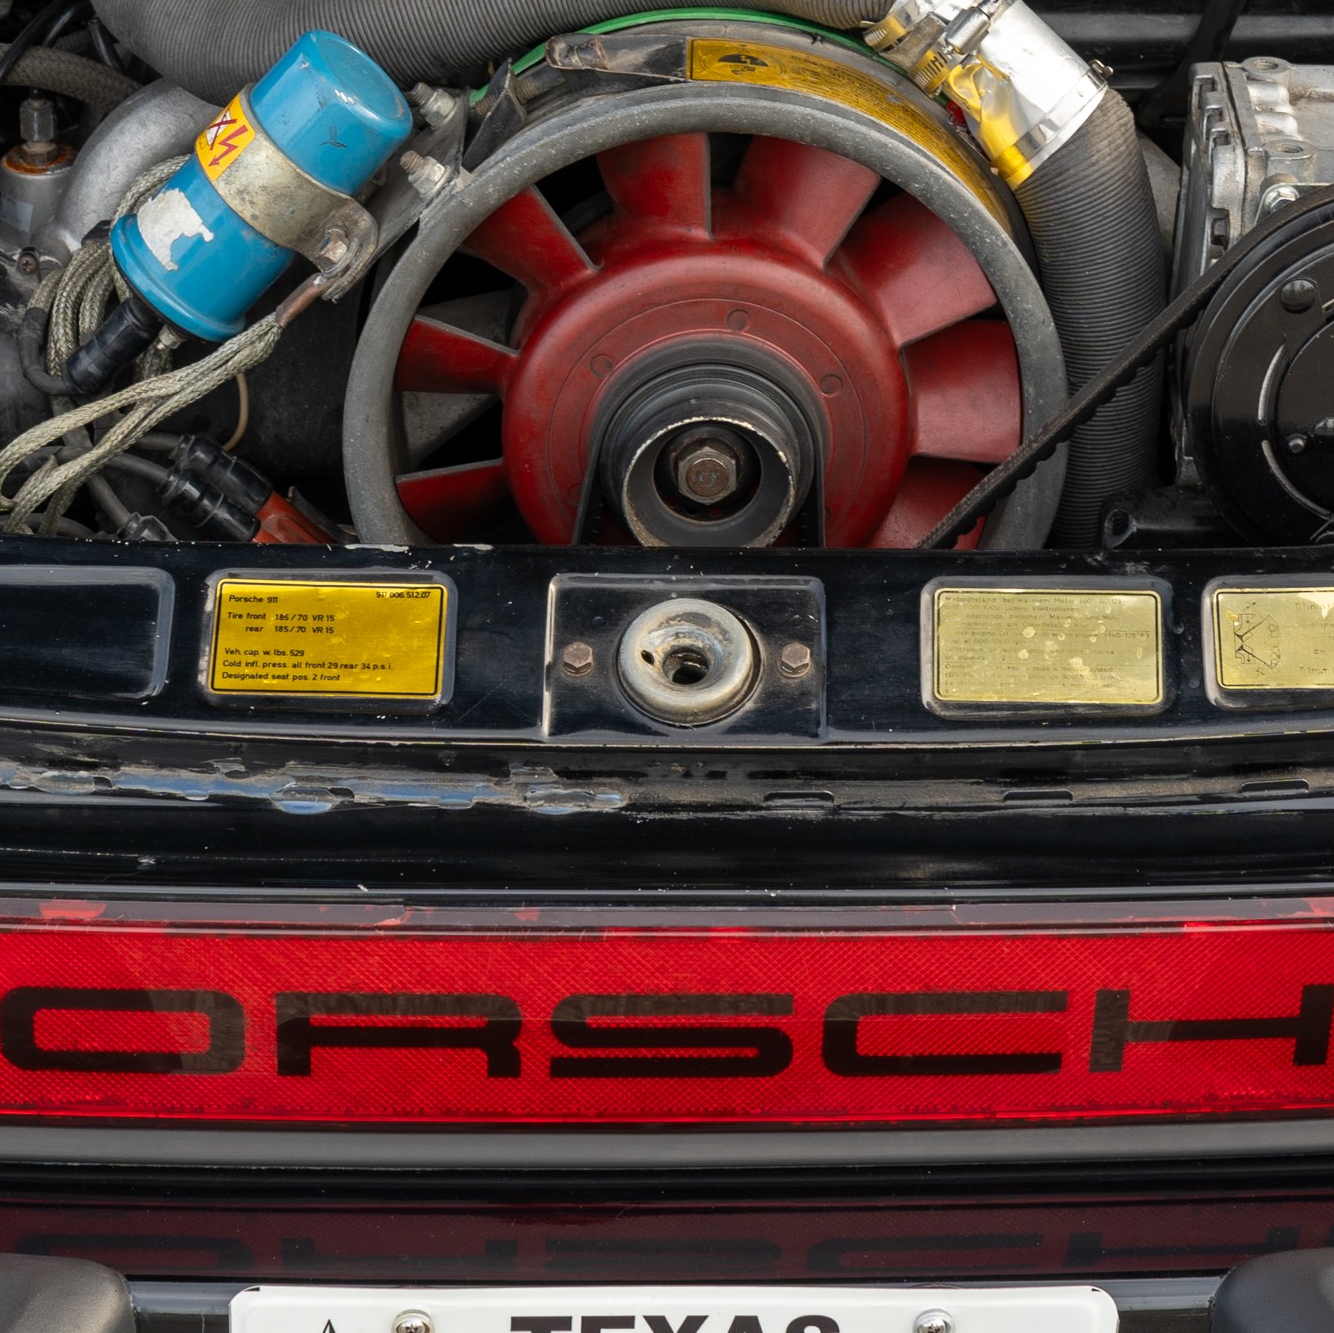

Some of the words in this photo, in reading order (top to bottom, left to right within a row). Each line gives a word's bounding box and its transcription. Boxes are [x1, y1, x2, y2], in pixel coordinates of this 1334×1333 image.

[229, 595, 264, 604] Porsche
[267, 596, 278, 604] 911
[227, 612, 243, 620] Tire
[246, 612, 266, 621] front
[312, 614, 325, 622] VR
[327, 614, 335, 622] 15
[312, 626, 324, 634] VR
[326, 626, 334, 634] 15
[225, 648, 241, 656] Veh.
[274, 649, 288, 657] lbs.
[290, 649, 305, 657] 529
[223, 660, 241, 668] Cold
[262, 662, 288, 670] press.
[292, 661, 303, 669] all
[305, 661, 326, 669] front
[222, 672, 269, 681] Designated
[292, 674, 310, 682] pos.
[320, 673, 340, 681] front
